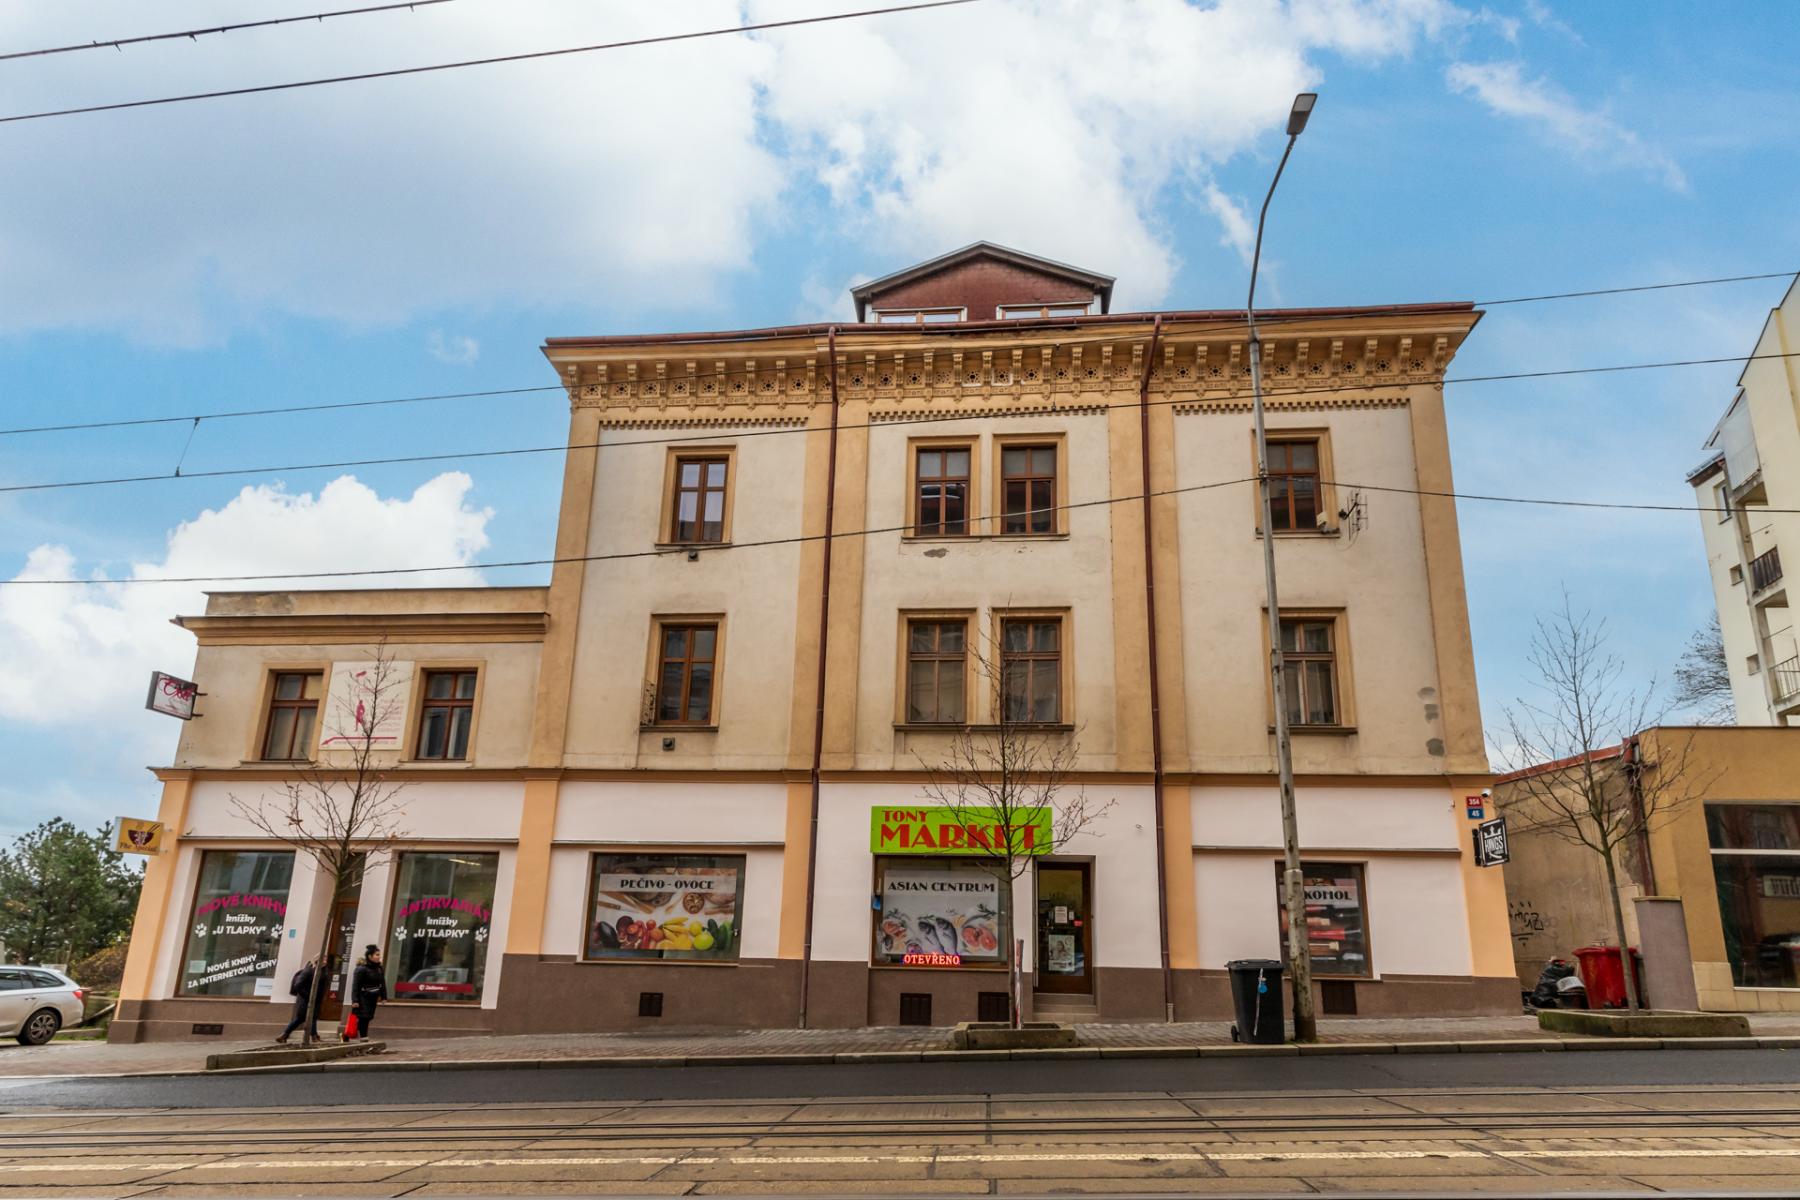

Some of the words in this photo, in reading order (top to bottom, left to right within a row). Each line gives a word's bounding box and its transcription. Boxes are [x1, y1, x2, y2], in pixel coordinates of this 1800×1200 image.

[884, 810, 928, 822] TONY
[881, 824, 1040, 849] MARKET
[621, 878, 665, 889] PEČIVO
[674, 880, 715, 889] OVOCE
[888, 882, 928, 892] ASIAN
[931, 882, 995, 893] CENTRUM
[1304, 890, 1352, 901] KOHOL
[197, 892, 241, 917] NOVÉ
[226, 913, 257, 925] knížky
[206, 959, 231, 974] NOVÉ
[231, 954, 257, 967] KNIHY
[903, 951, 960, 965] OTEVŘENO
[199, 964, 255, 985] INTERNETOVÉ
